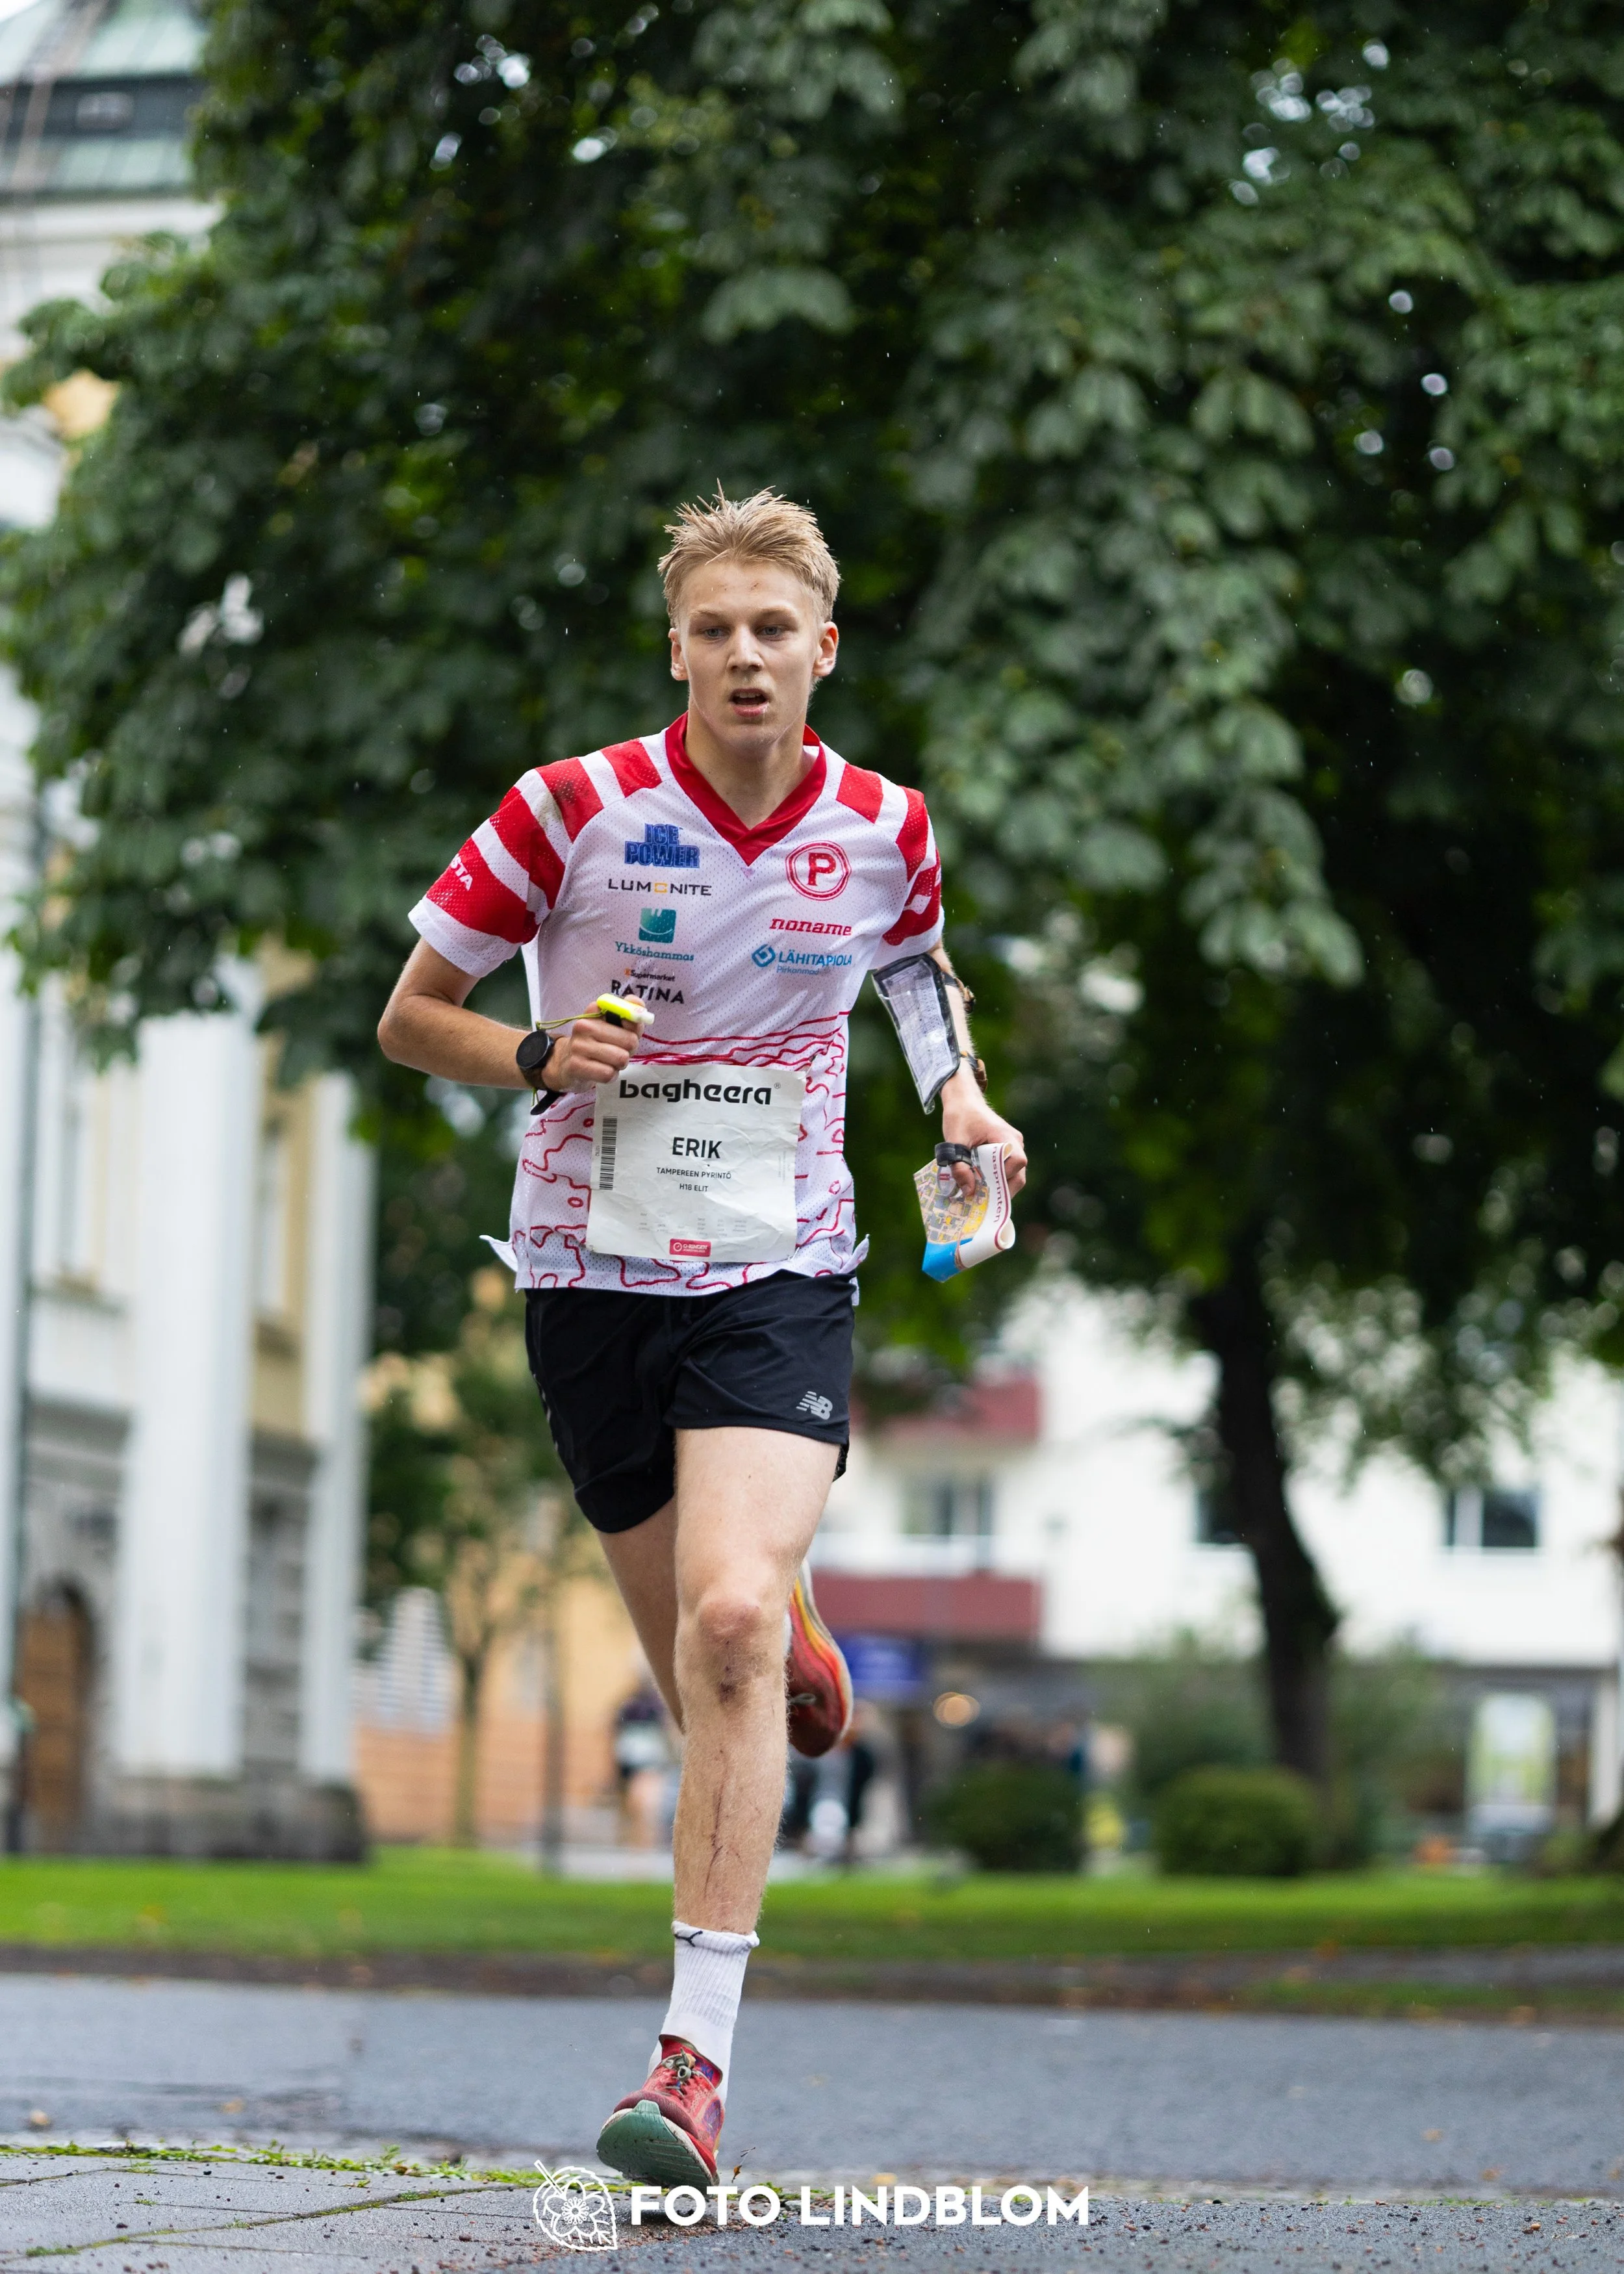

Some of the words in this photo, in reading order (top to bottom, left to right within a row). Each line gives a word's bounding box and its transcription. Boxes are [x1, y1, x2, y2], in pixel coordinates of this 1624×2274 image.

[644, 823, 680, 845] ICE
[624, 841, 700, 868] POWER
[807, 852, 836, 886] P
[608, 878, 712, 896] LUMONITE
[769, 918, 852, 936] noname
[615, 941, 694, 961] Ykköshammas
[778, 949, 852, 967] LÄHITAPIOLA
[611, 979, 684, 1004] RATINA
[619, 1079, 772, 1105] bagheera
[672, 1136, 723, 1159] ERIK
[656, 1167, 700, 1177] TAMPEREEN
[701, 1171, 731, 1179] PYRINTÖ
